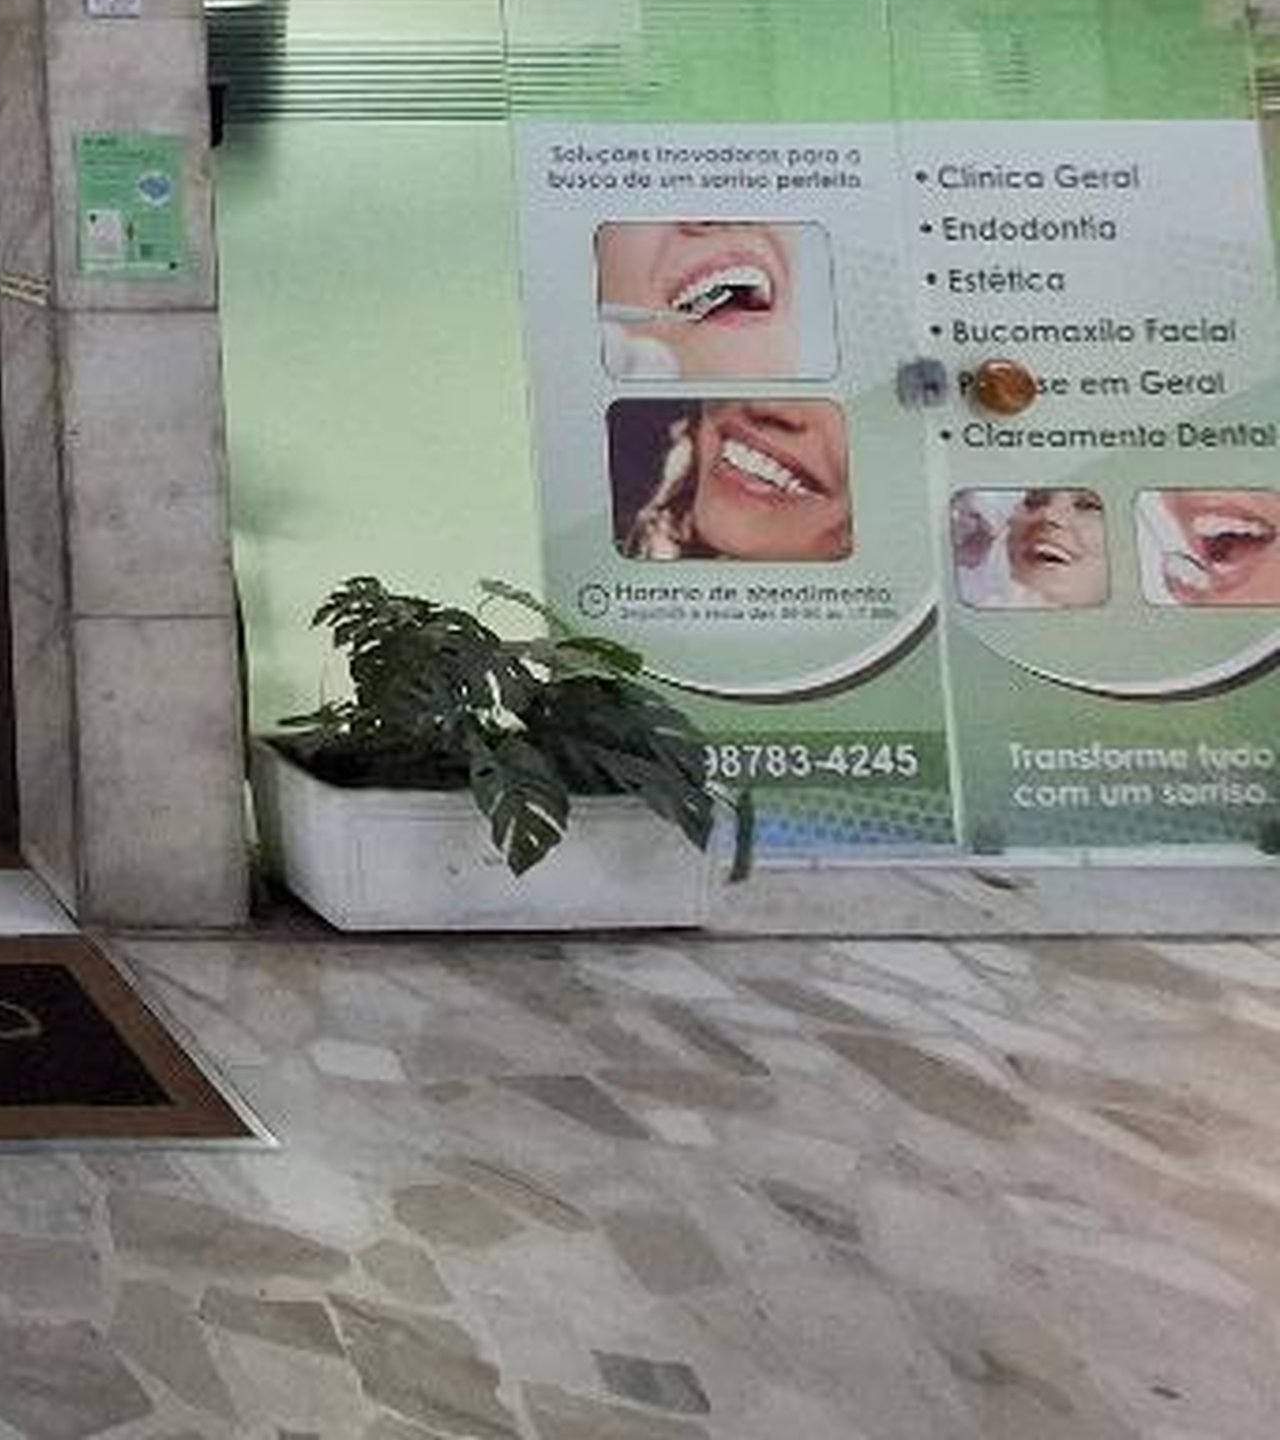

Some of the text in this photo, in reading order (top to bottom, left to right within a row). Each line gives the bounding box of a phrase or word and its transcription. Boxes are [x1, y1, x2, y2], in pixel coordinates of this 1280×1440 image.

[1054, 164, 1140, 189] Geral
[942, 216, 1118, 241] Endodontia
[948, 265, 1066, 293] Estética
[1144, 317, 1238, 343] Facial
[1080, 377, 1130, 395] em
[1140, 370, 1226, 395] Geral
[963, 421, 1277, 448] Clareamento Dental
[1009, 741, 1188, 770] Transforme
[1012, 783, 1089, 808] com
[1098, 783, 1153, 807] um
